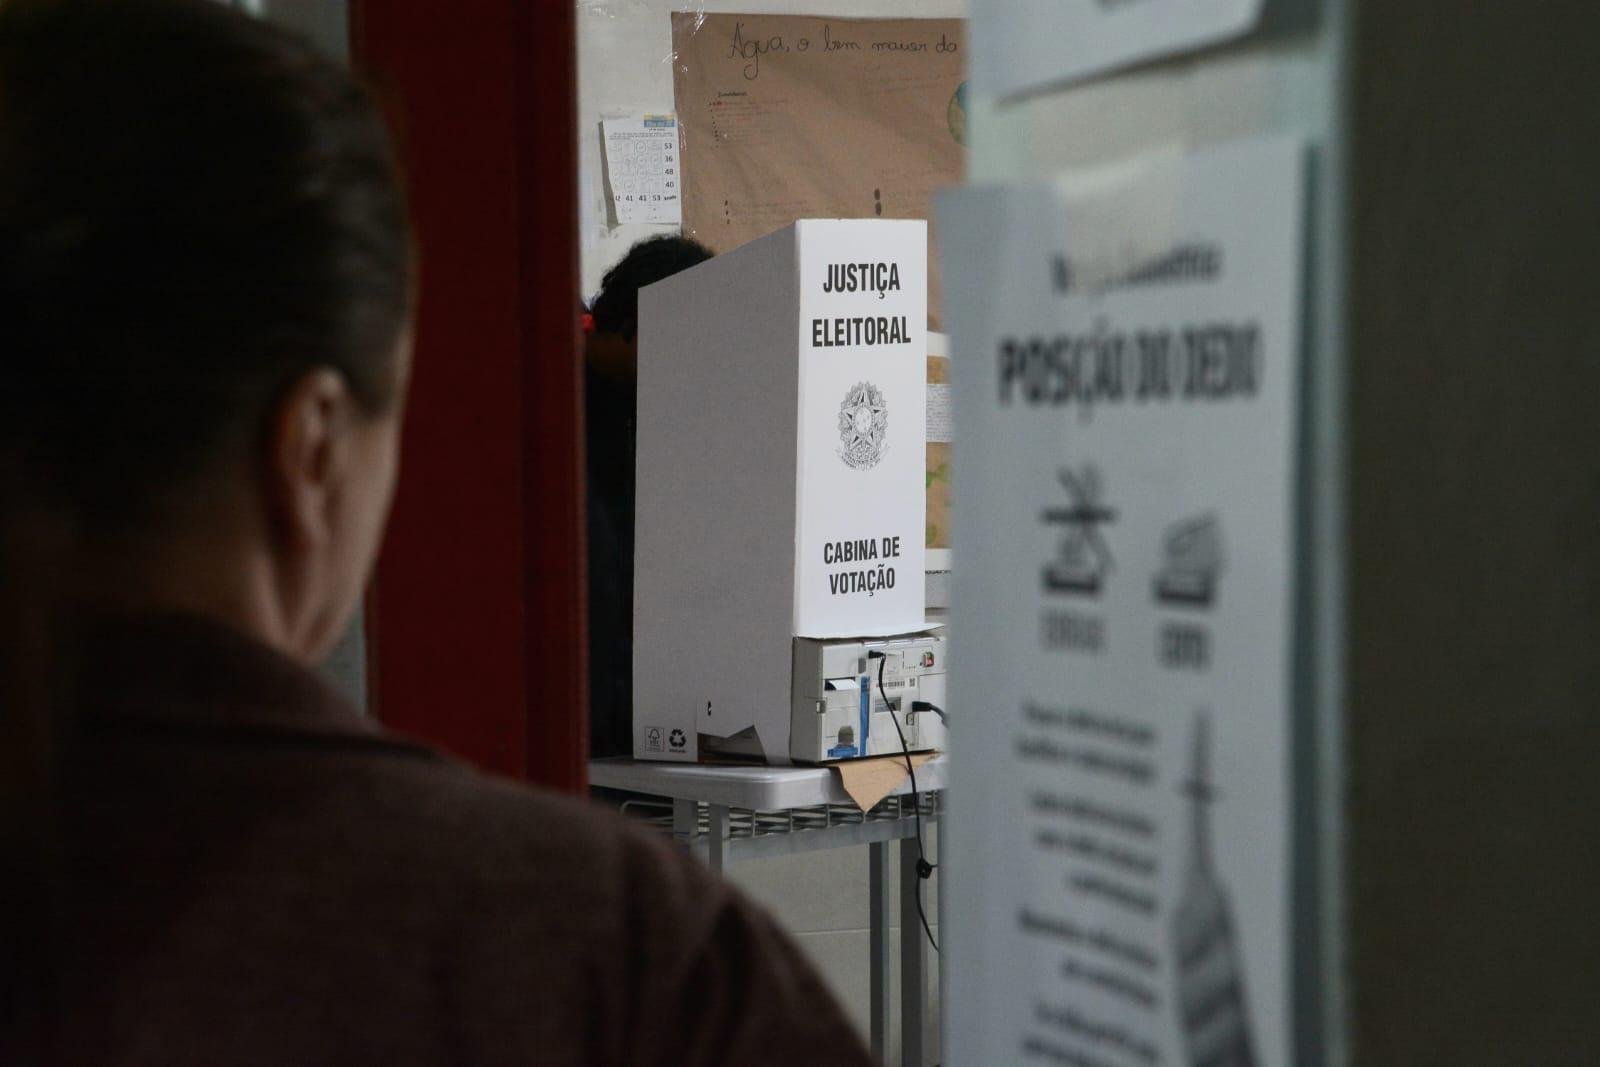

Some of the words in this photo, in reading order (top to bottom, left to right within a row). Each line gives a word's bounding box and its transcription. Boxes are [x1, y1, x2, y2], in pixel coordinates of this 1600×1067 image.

[797, 37, 810, 53] o
[823, 24, 861, 52] bem
[871, 37, 928, 53] maior
[823, 262, 901, 300] JUSTIÇA
[812, 316, 912, 348] ELEITORAL
[823, 538, 878, 564] CABINA
[882, 536, 900, 559] DE
[829, 563, 895, 597] VOTAÇÃO
